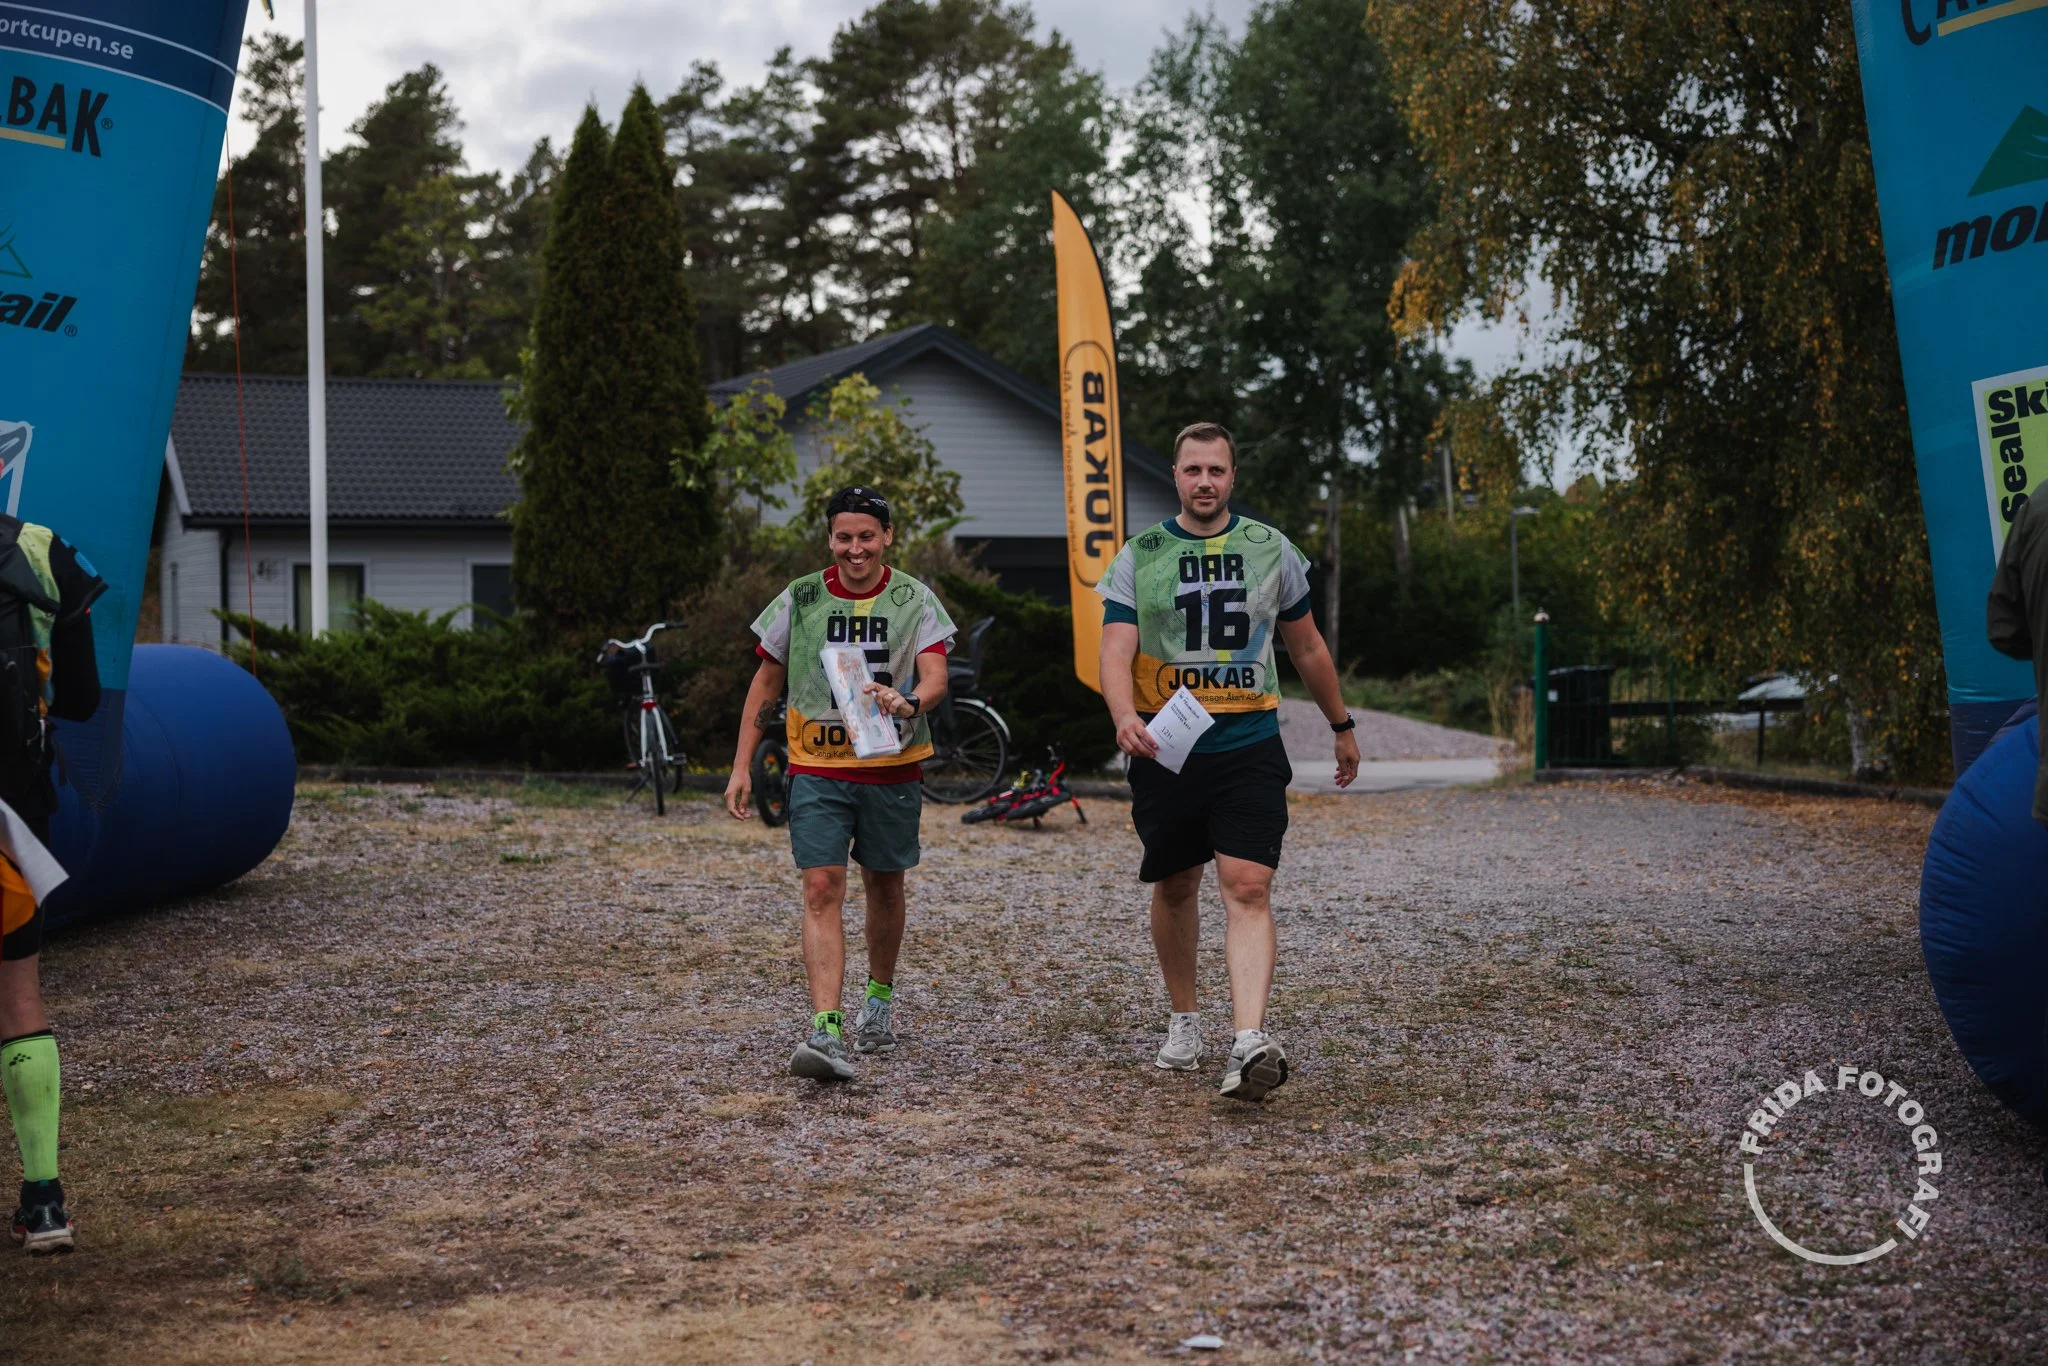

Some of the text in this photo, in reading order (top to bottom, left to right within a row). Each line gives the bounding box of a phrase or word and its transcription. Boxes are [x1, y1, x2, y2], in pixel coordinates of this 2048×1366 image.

[1988, 381, 2048, 424] Sk
[1178, 550, 1245, 584] ÖAR
[827, 610, 888, 643] ÖAR
[1174, 587, 1250, 652] 16
[1168, 667, 1256, 690] JOKAB
